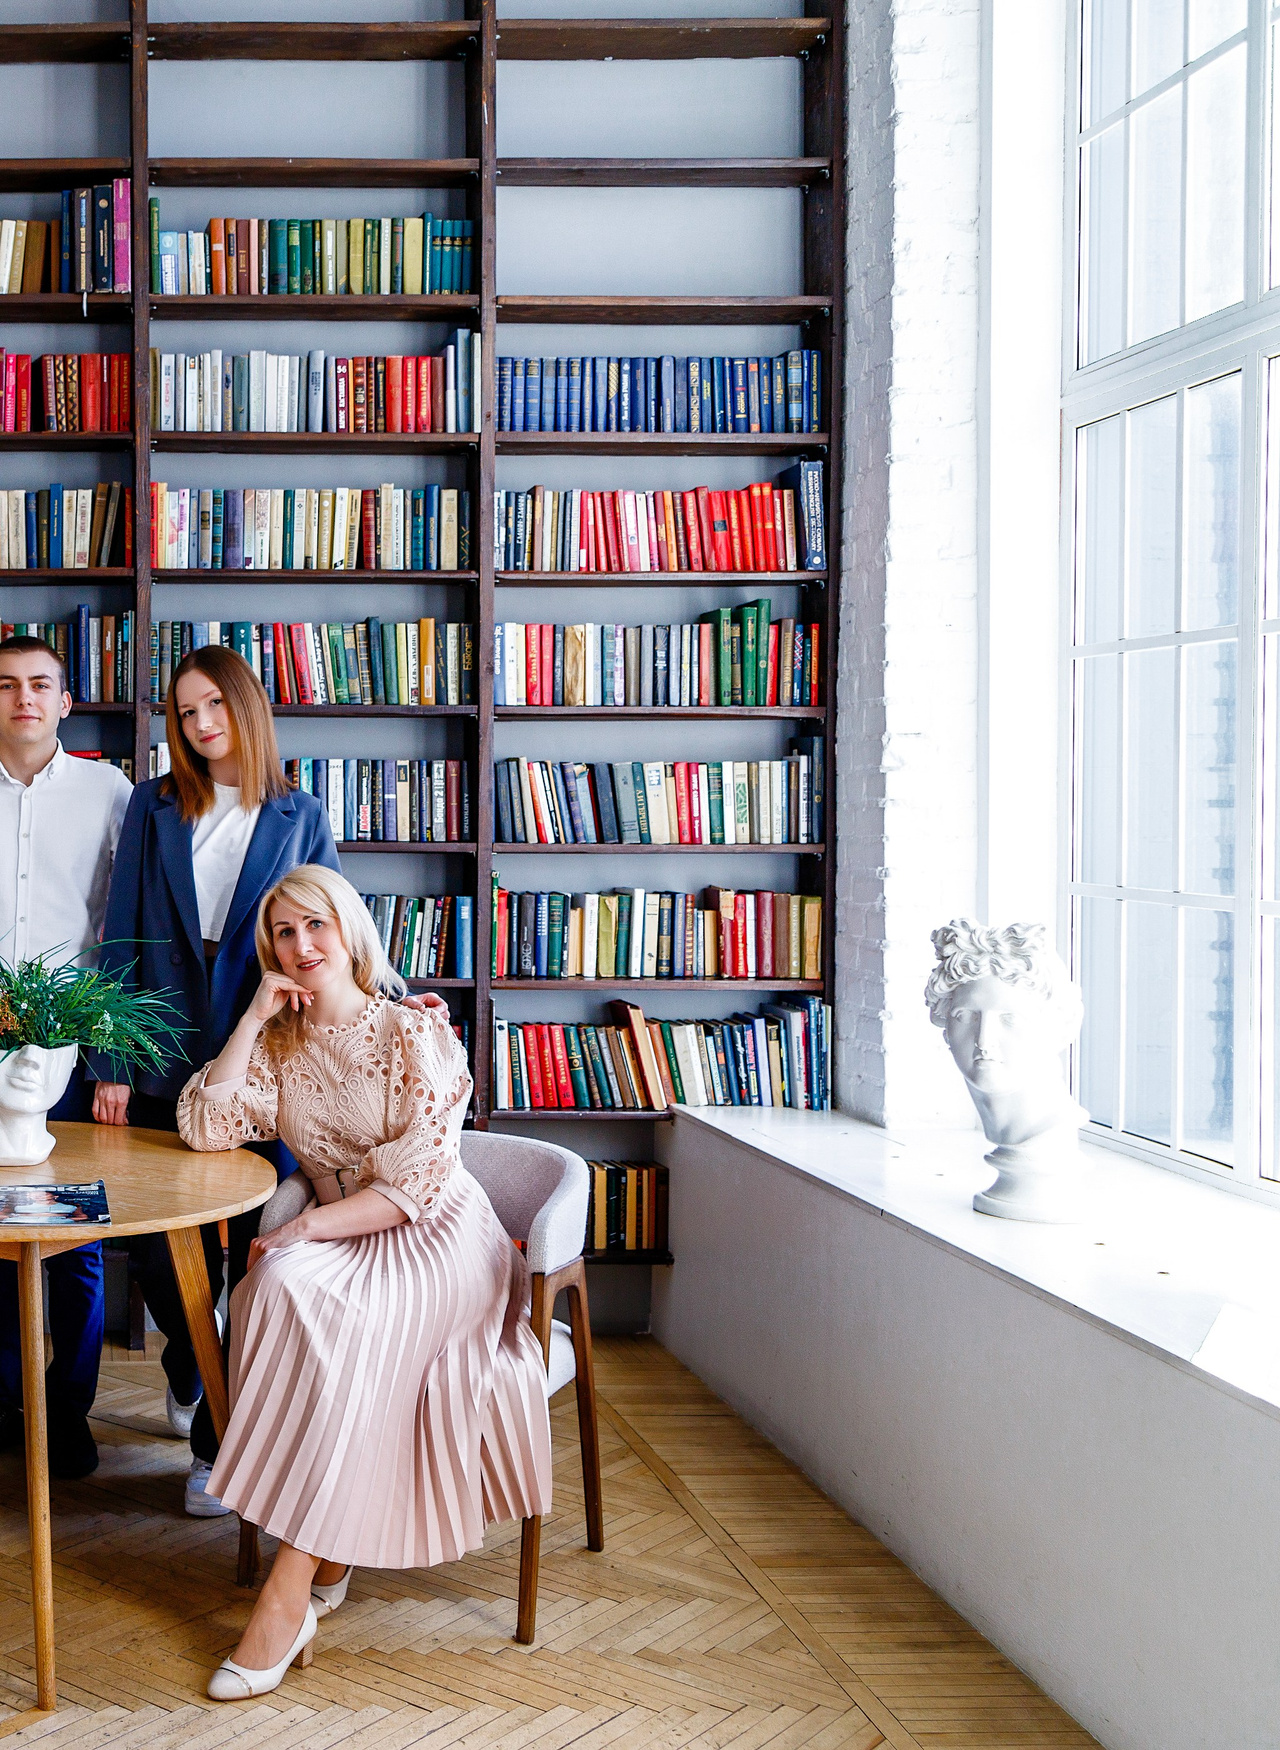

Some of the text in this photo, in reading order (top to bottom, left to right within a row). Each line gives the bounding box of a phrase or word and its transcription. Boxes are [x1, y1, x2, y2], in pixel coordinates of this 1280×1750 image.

[807, 470, 817, 550] RUSSIAN-ENGLISH DICTIONARY
[813, 470, 821, 527] РУССКО-АНГЛИЙСКИЙ
[463, 641, 472, 670] БЫКОВ
[360, 804, 369, 829] МАФИЯ
[435, 797, 444, 822] Банда
[746, 1029, 755, 1070] А.МАРИНИНА
[794, 1038, 804, 1084] Ветер странствий
